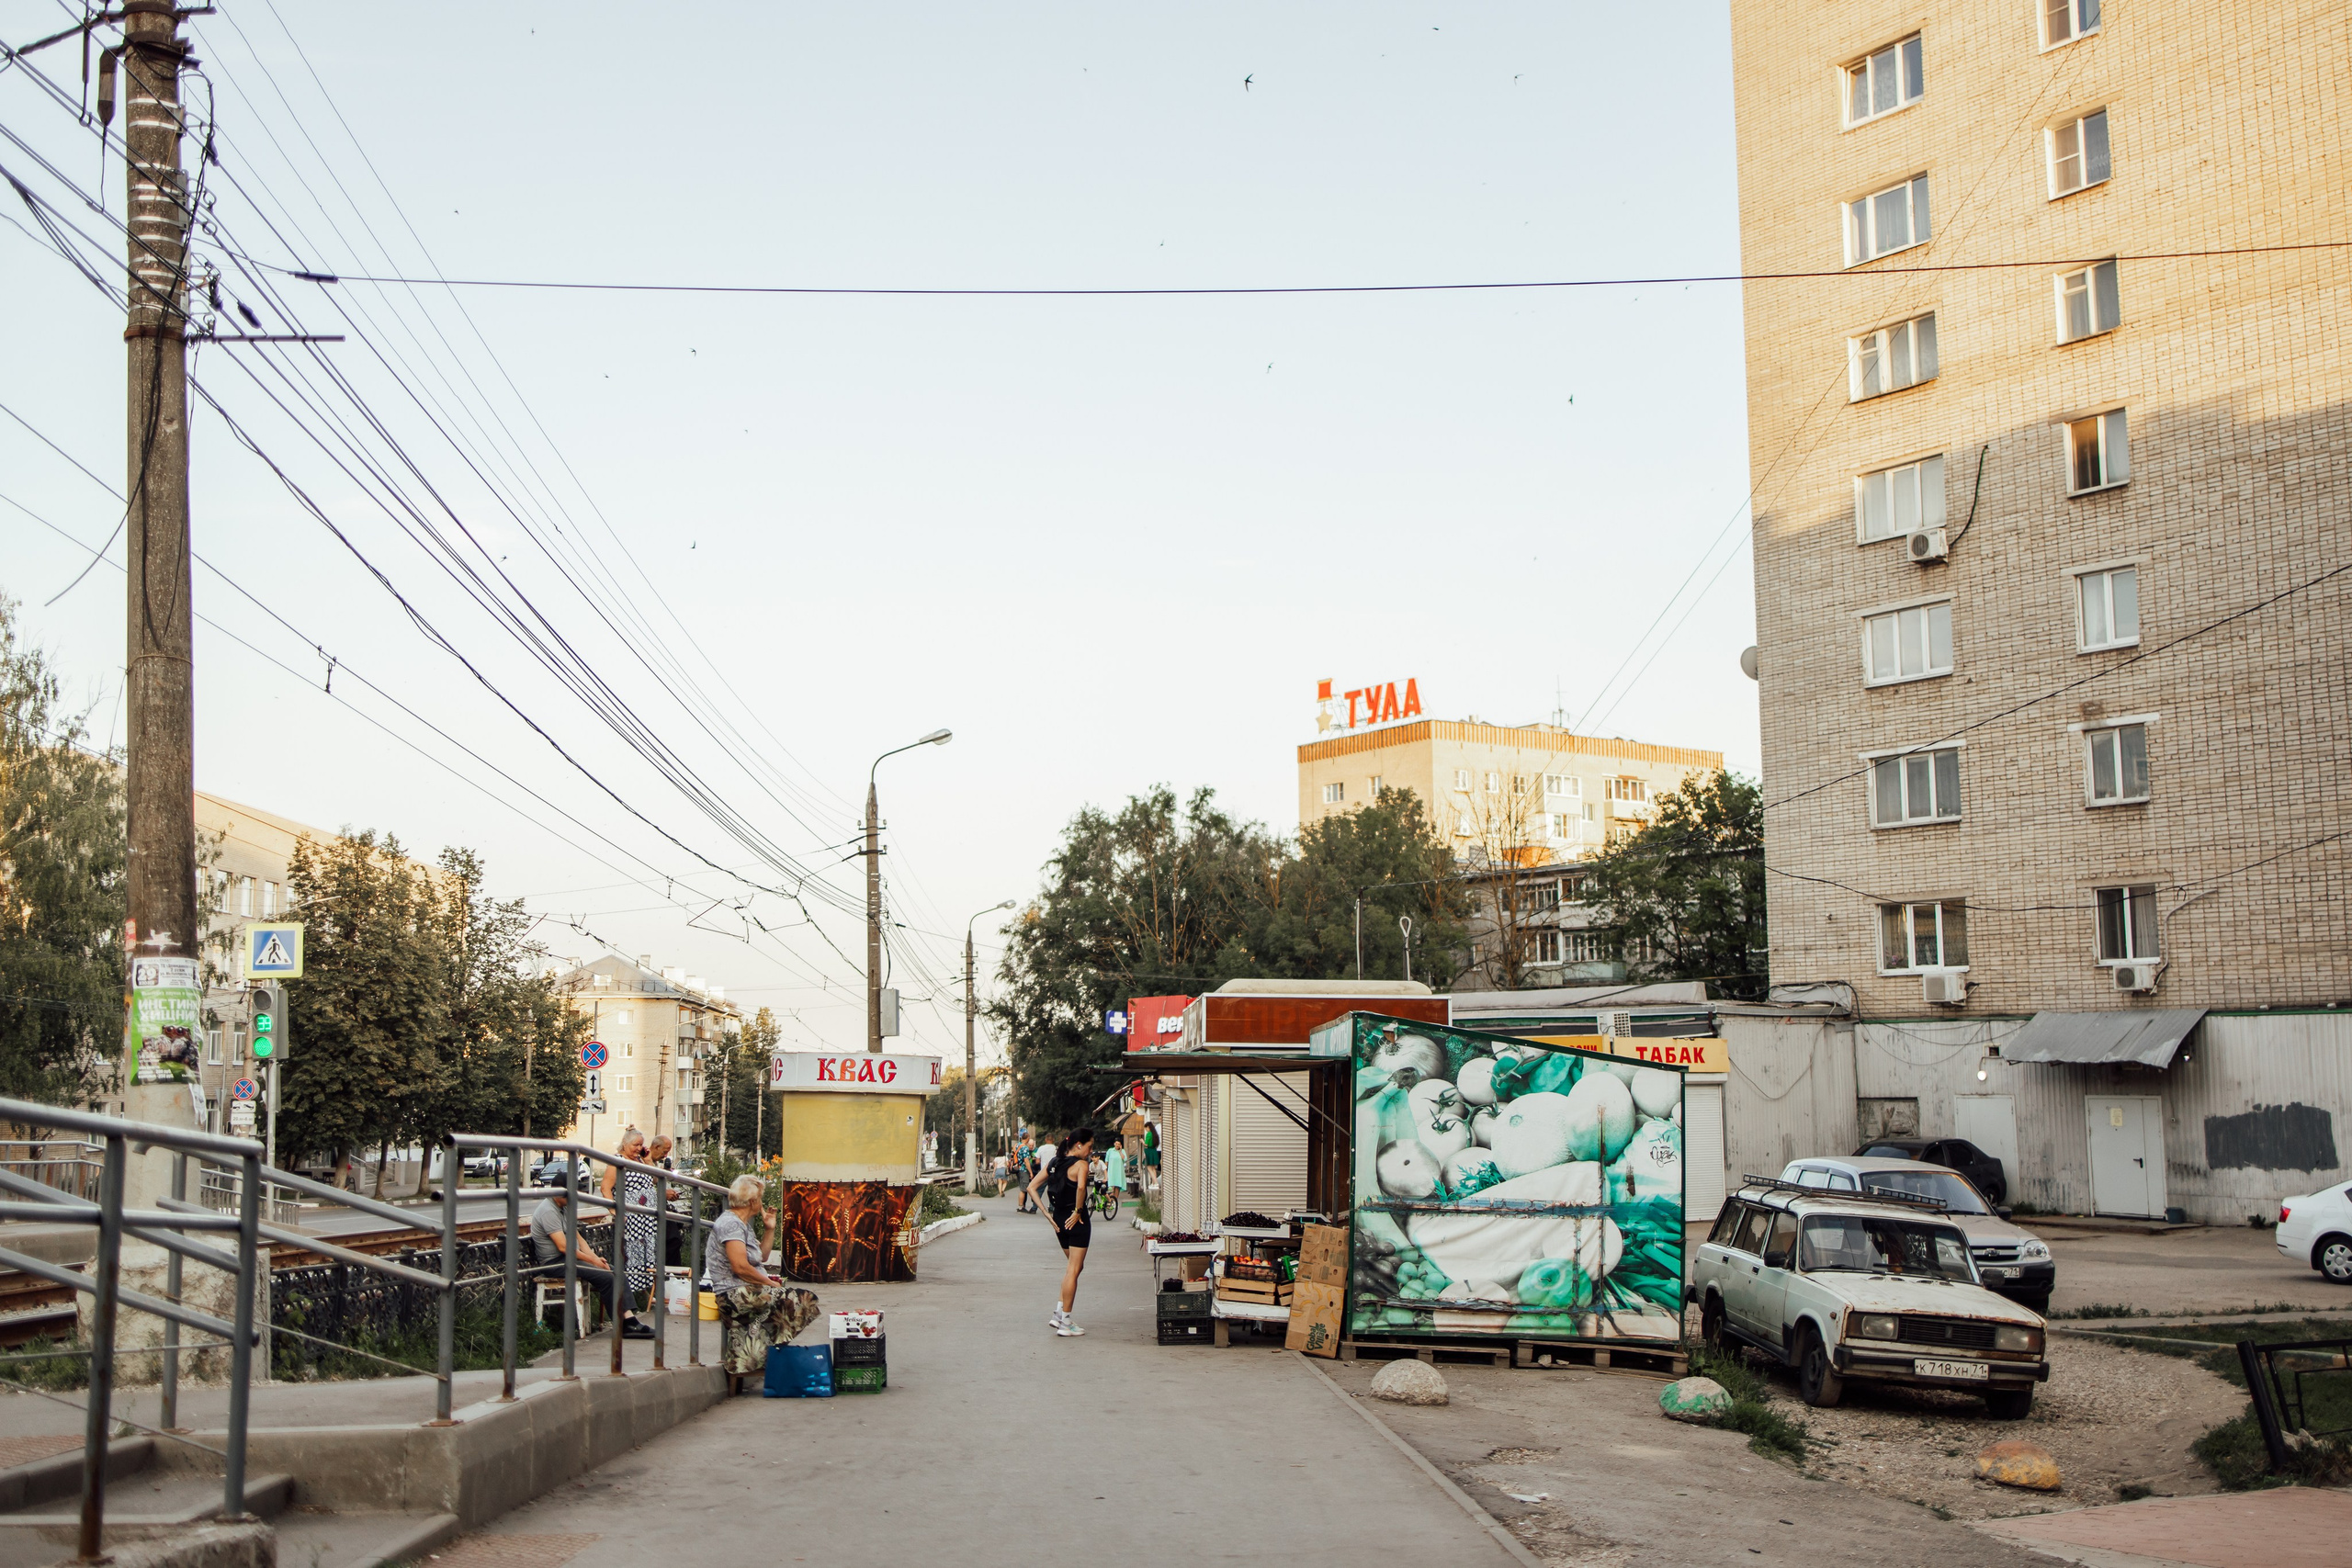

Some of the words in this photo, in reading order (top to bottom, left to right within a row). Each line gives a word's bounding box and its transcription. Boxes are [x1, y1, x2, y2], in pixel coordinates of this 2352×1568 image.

[1344, 678, 1422, 728] ТУЛА
[1635, 1046, 1705, 1064] ТАБАК
[817, 1058, 897, 1083] КВАС
[1306, 1325, 1316, 1351] Global
